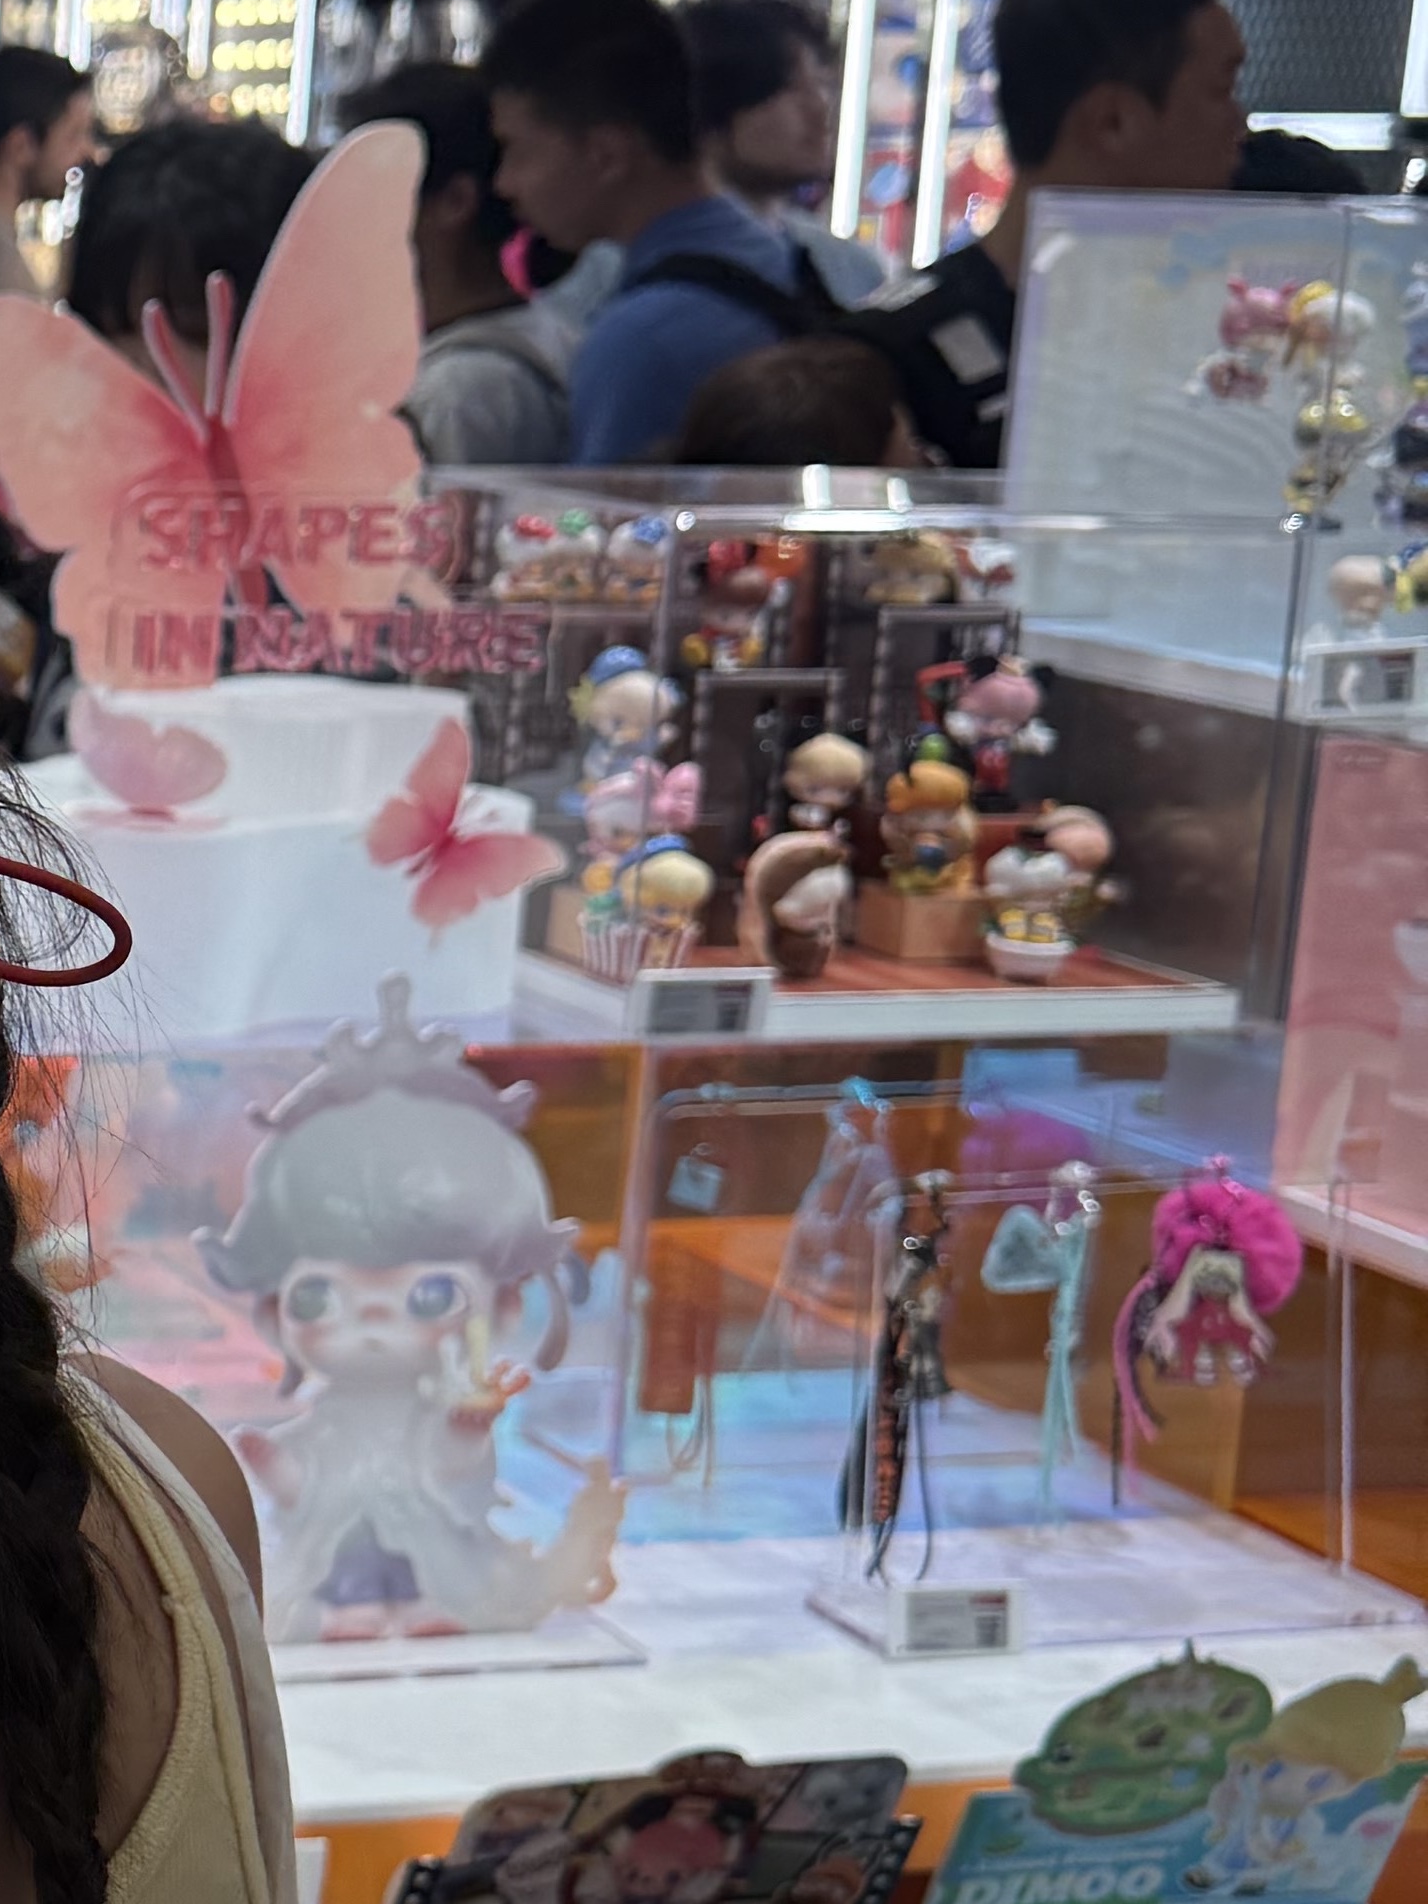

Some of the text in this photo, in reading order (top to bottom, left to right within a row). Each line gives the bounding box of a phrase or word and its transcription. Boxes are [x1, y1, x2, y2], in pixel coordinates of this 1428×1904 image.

[142, 500, 454, 571] SHAPES
[134, 604, 546, 676] IN NATURE
